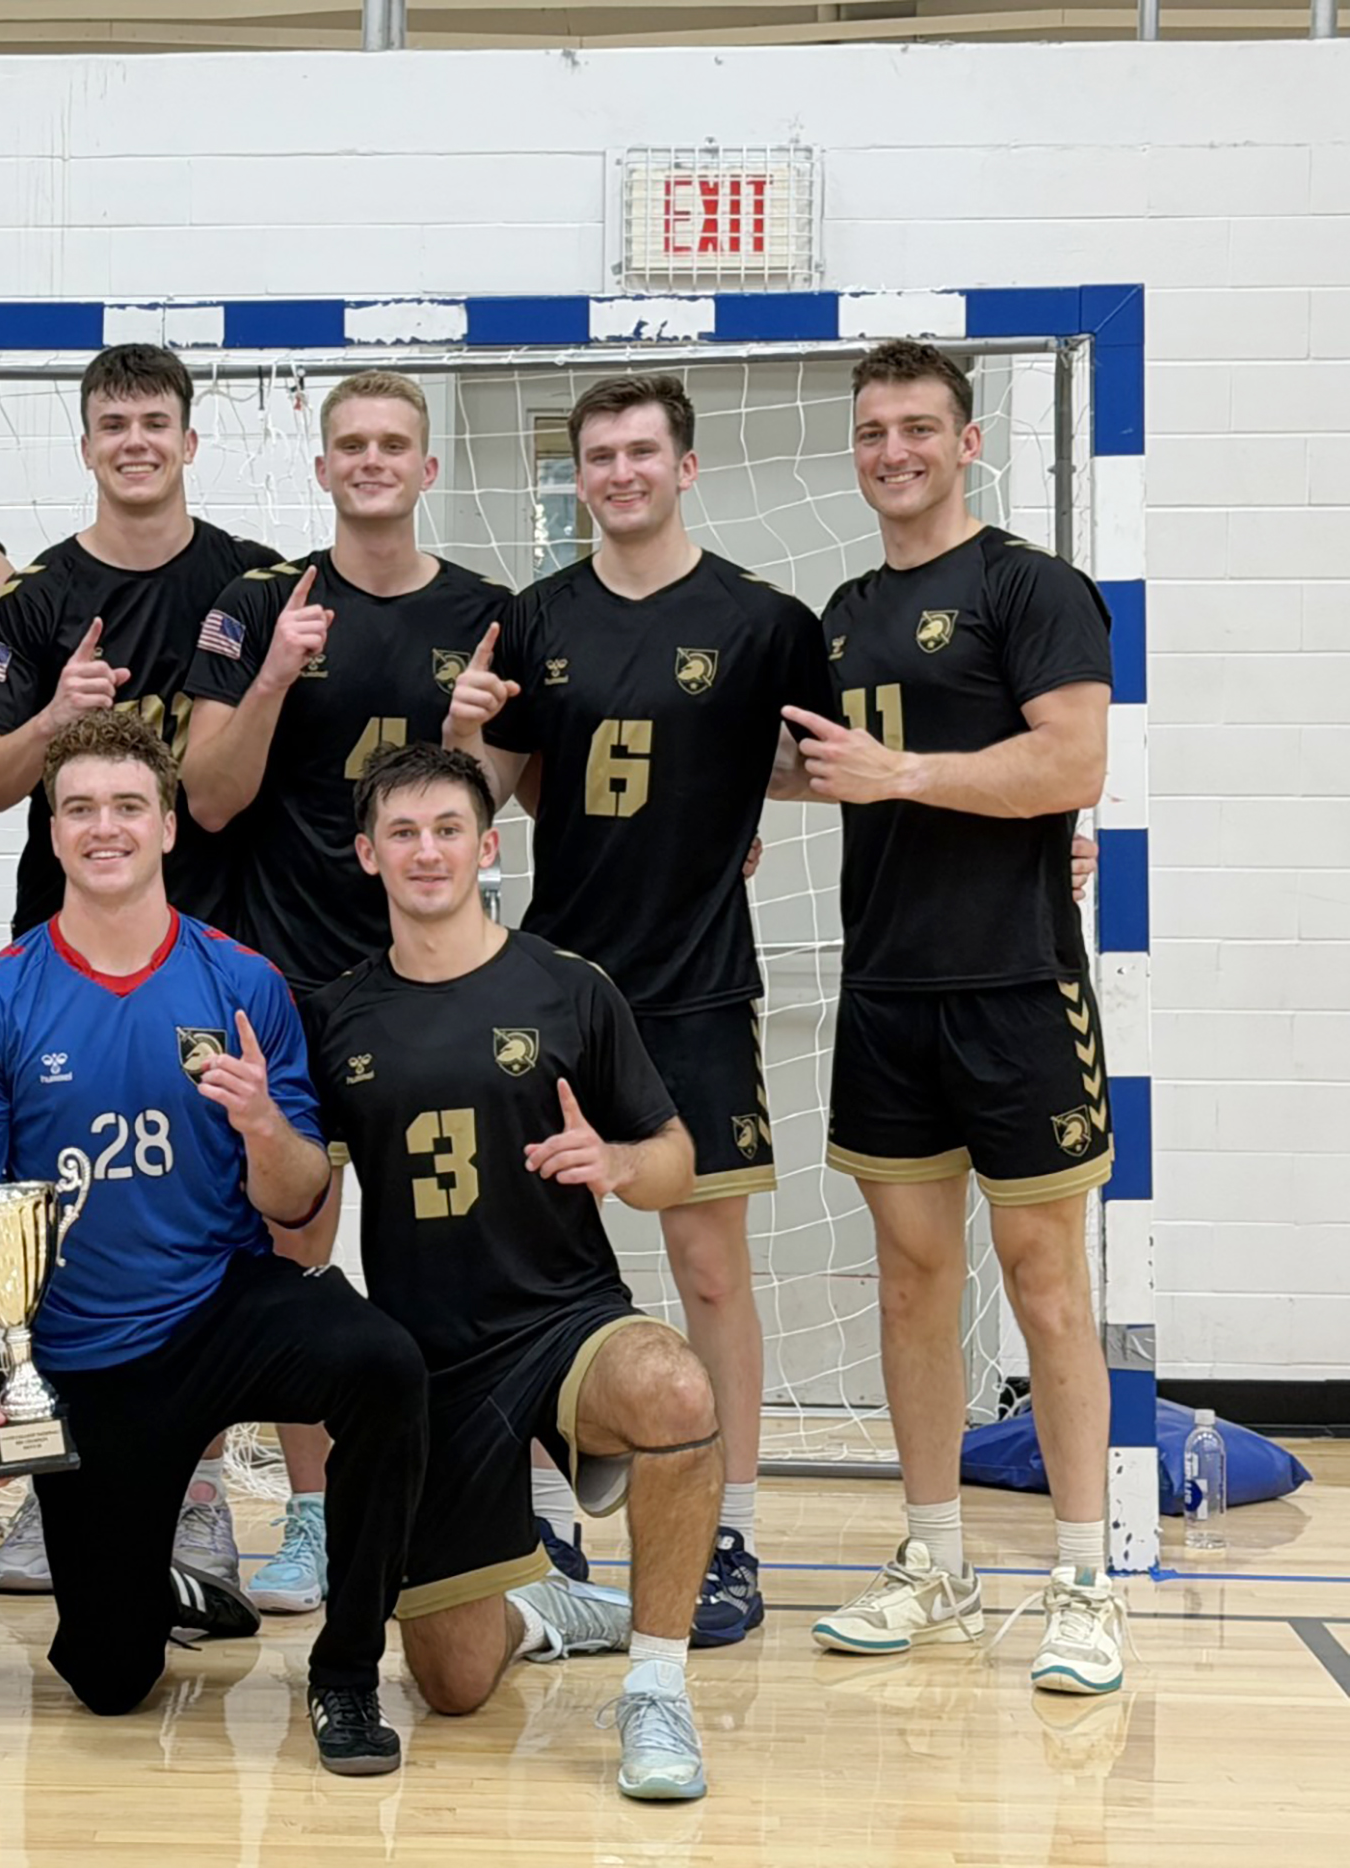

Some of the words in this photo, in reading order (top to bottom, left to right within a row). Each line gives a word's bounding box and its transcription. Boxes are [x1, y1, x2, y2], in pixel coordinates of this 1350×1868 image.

[664, 173, 773, 256] EXIT
[344, 717, 407, 779] 4
[584, 719, 653, 818] 6
[90, 1109, 174, 1181] 28
[405, 1107, 480, 1220] 3
